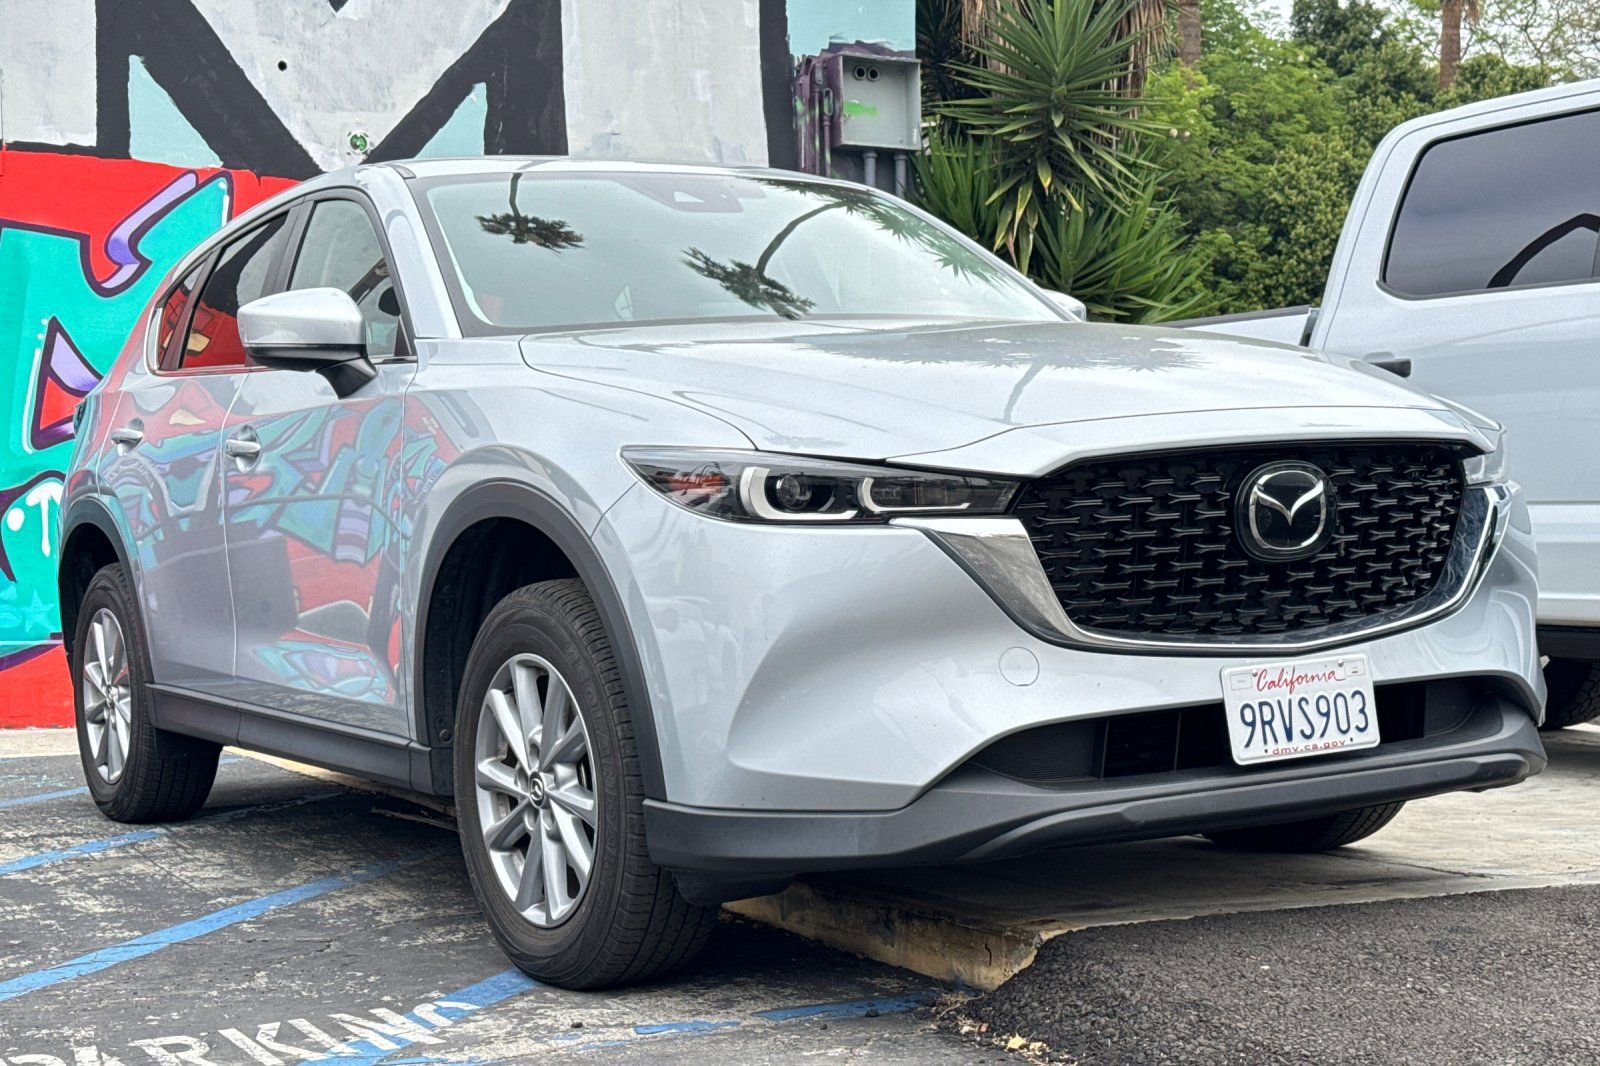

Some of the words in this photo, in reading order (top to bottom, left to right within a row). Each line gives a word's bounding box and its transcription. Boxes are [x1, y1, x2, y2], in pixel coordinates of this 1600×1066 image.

[1256, 665, 1346, 694] California
[1239, 689, 1369, 749] 9RVS903
[1272, 739, 1346, 756] dmv.ca.gov
